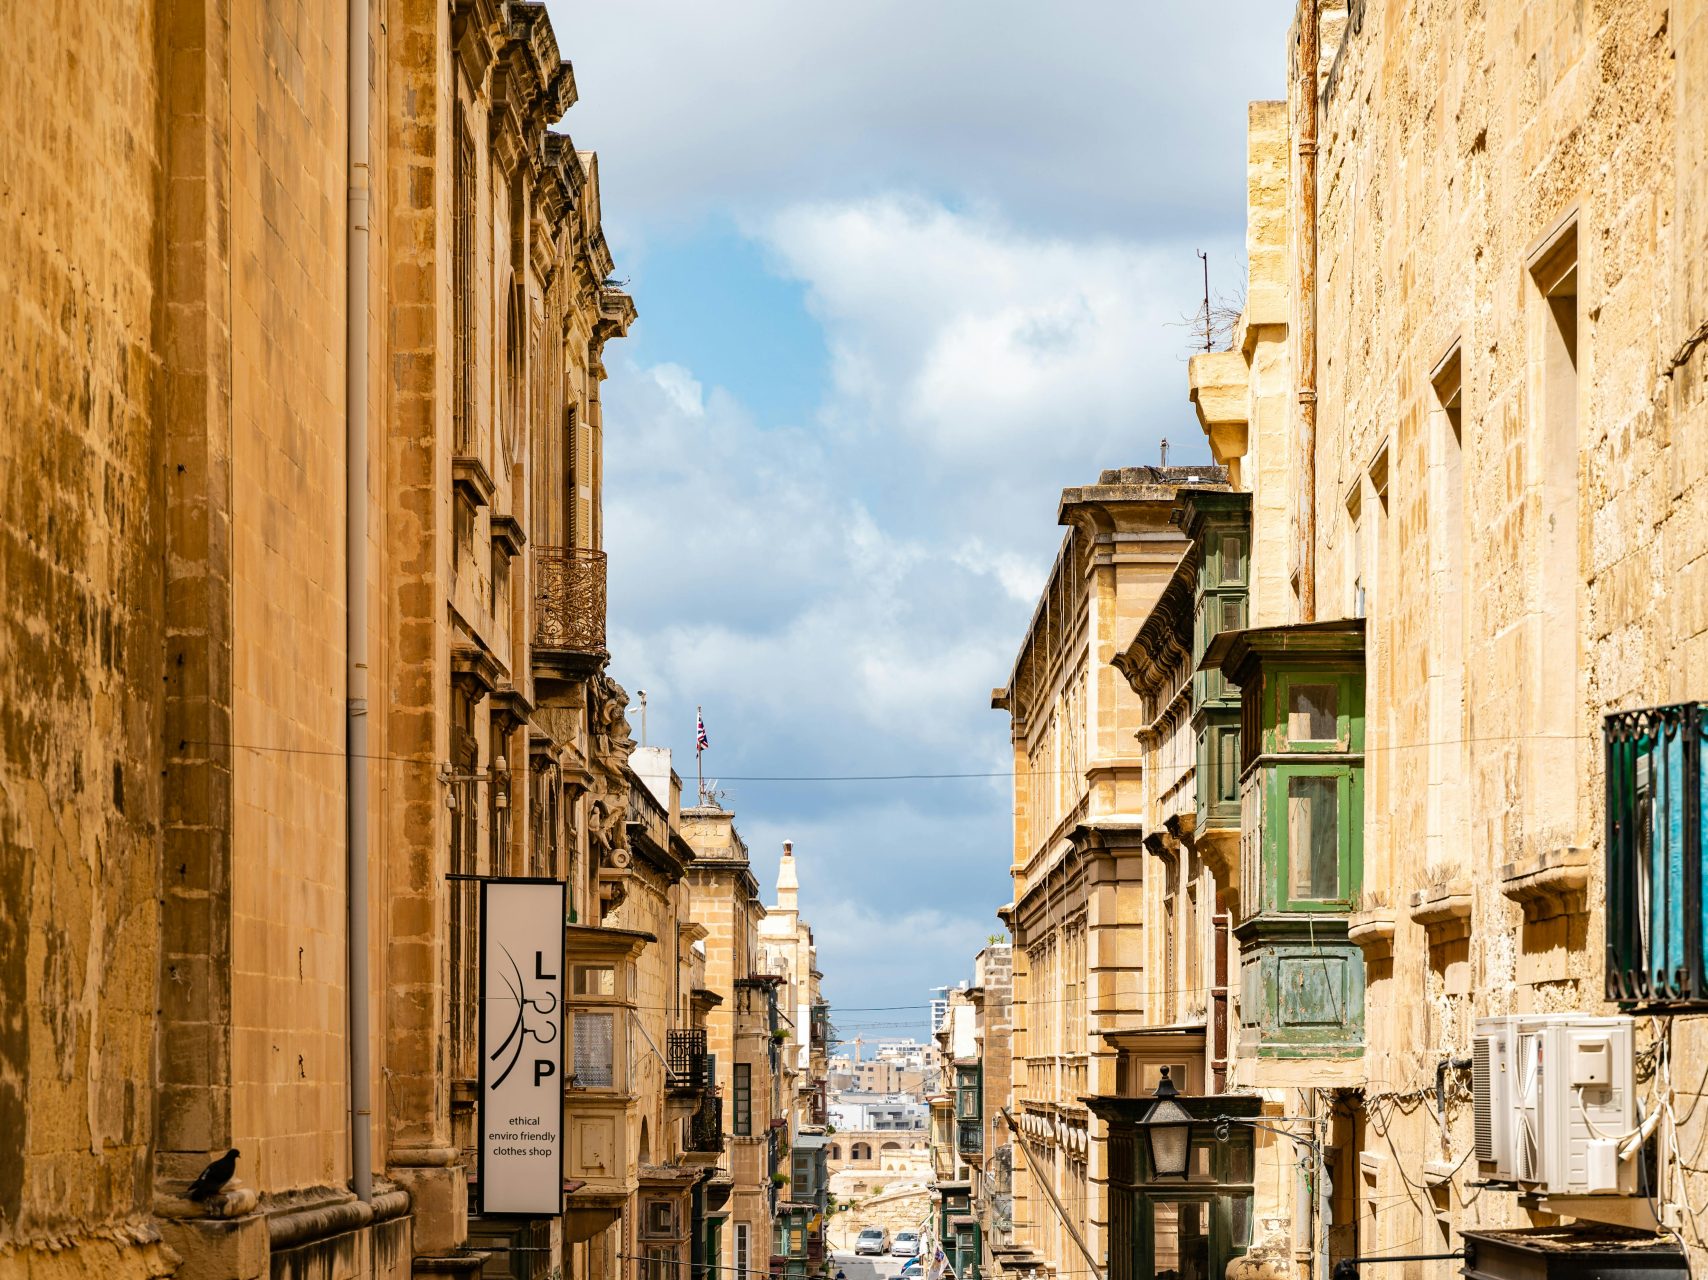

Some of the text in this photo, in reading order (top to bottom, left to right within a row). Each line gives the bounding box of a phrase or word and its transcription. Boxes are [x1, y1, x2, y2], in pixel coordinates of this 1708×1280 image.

[509, 1116, 540, 1126] ethical
[489, 1130, 556, 1143] enviro friendly
[493, 1146, 552, 1159] clothes shop
